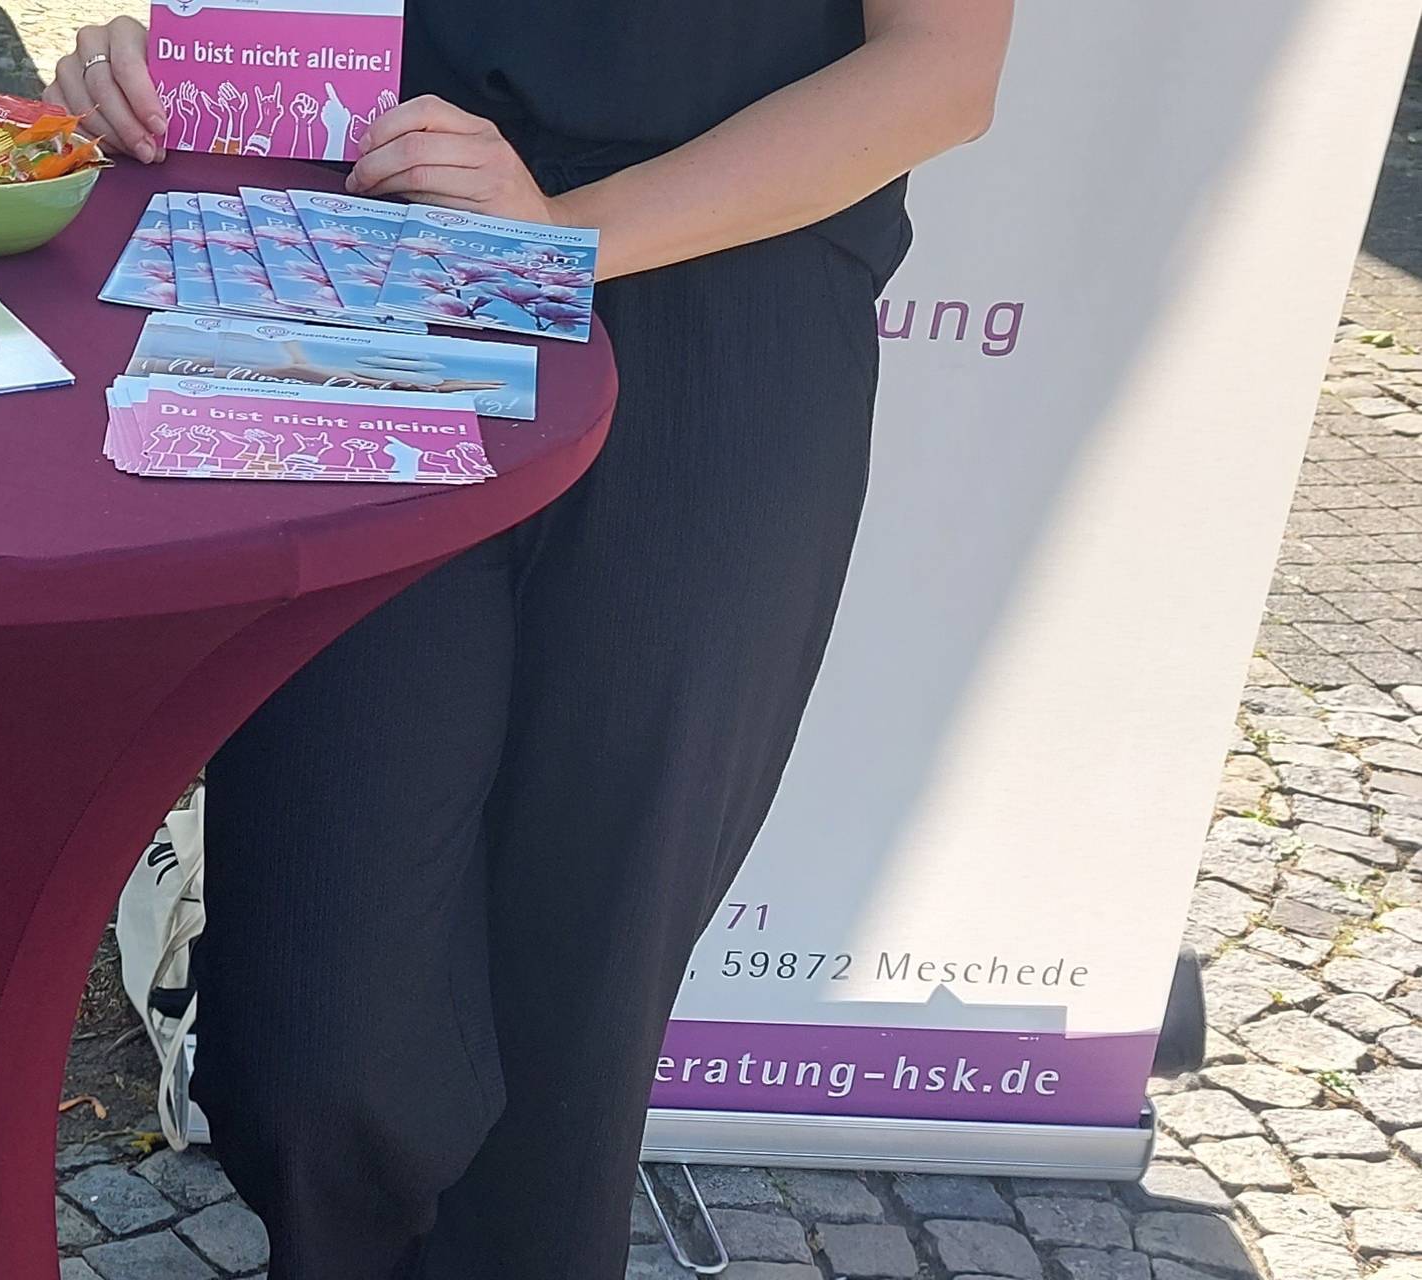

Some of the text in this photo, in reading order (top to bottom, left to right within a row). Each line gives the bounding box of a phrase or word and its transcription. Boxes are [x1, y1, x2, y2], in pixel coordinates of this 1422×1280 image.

[158, 38, 392, 72] Du bist nicht alleine!
[161, 404, 468, 436] Du bist nicht alleine!
[726, 903, 769, 931] 71
[721, 950, 1090, 987] 59872 Meschede
[654, 1052, 1061, 1097] eratung-hsk.de
